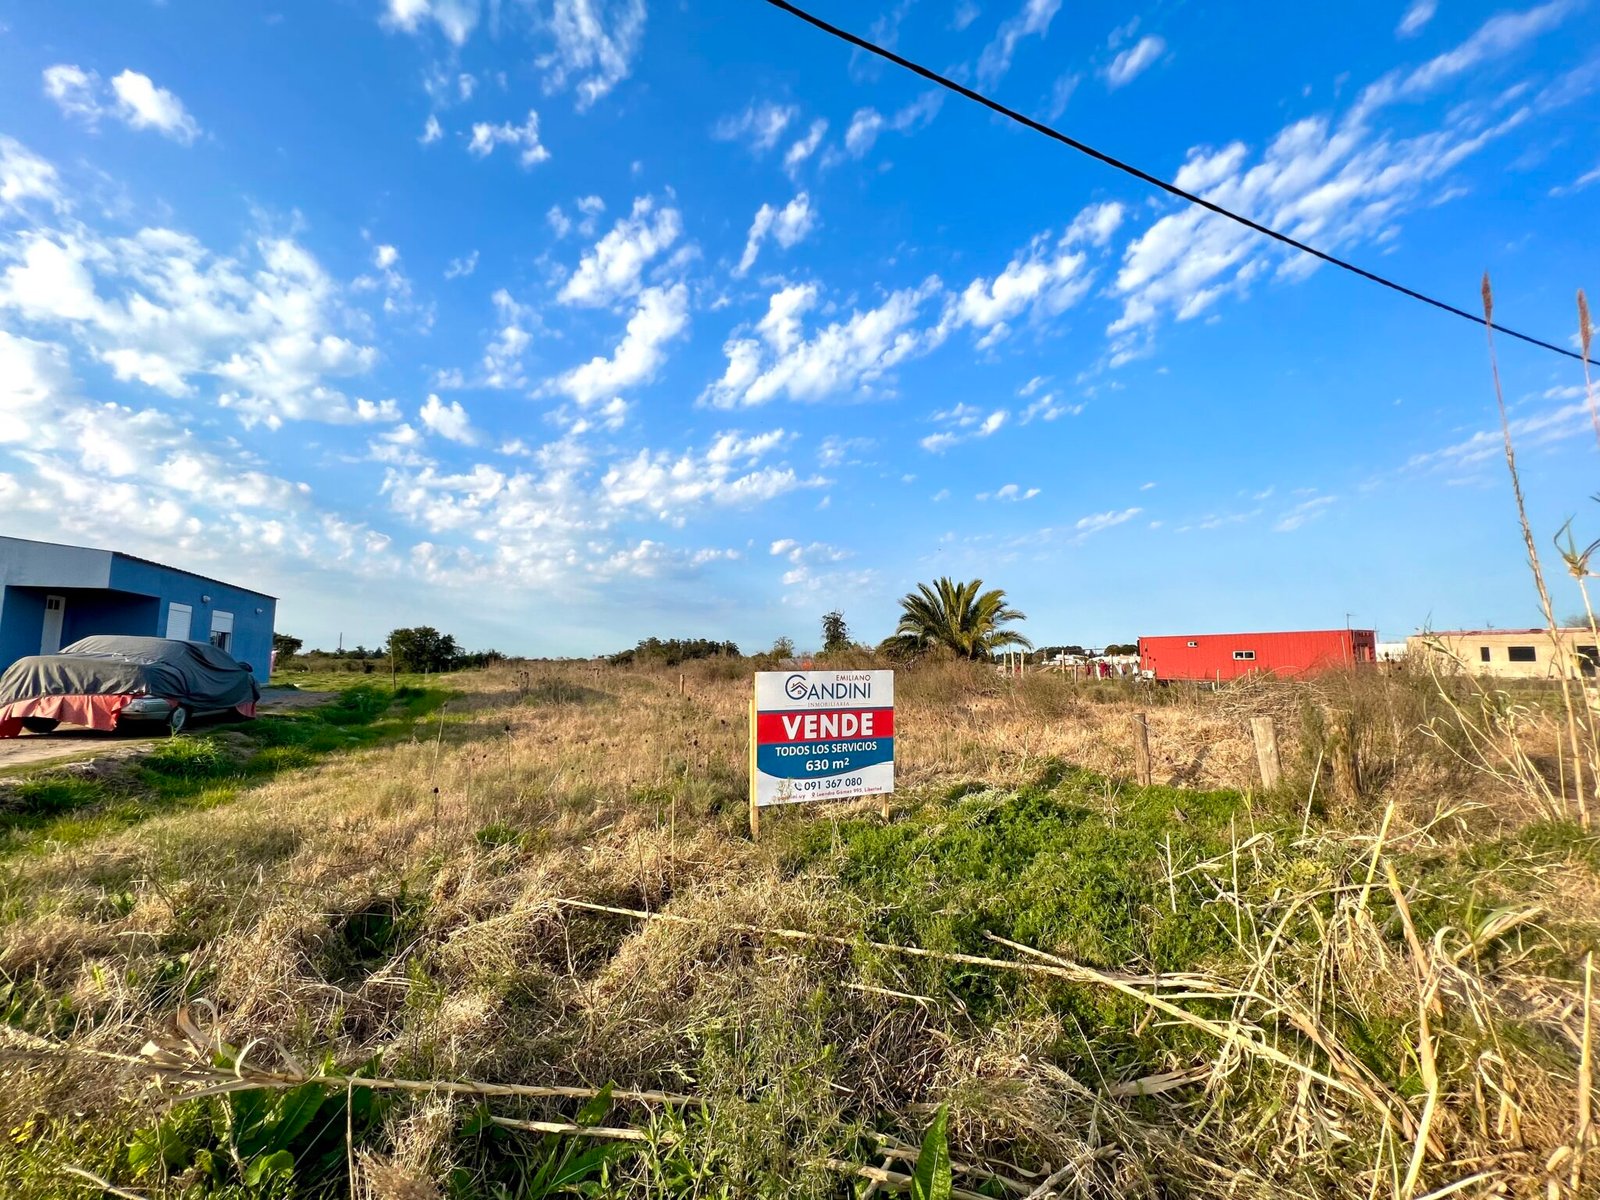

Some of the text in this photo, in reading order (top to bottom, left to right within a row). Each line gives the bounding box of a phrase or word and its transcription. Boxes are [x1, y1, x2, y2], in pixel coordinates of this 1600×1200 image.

[785, 674, 871, 700] GANDINI
[782, 712, 873, 740] VENDE
[775, 741, 877, 756] TODOS LOS SERVICIOS
[806, 759, 829, 771] 630
[804, 777, 862, 790] 091 367 080
